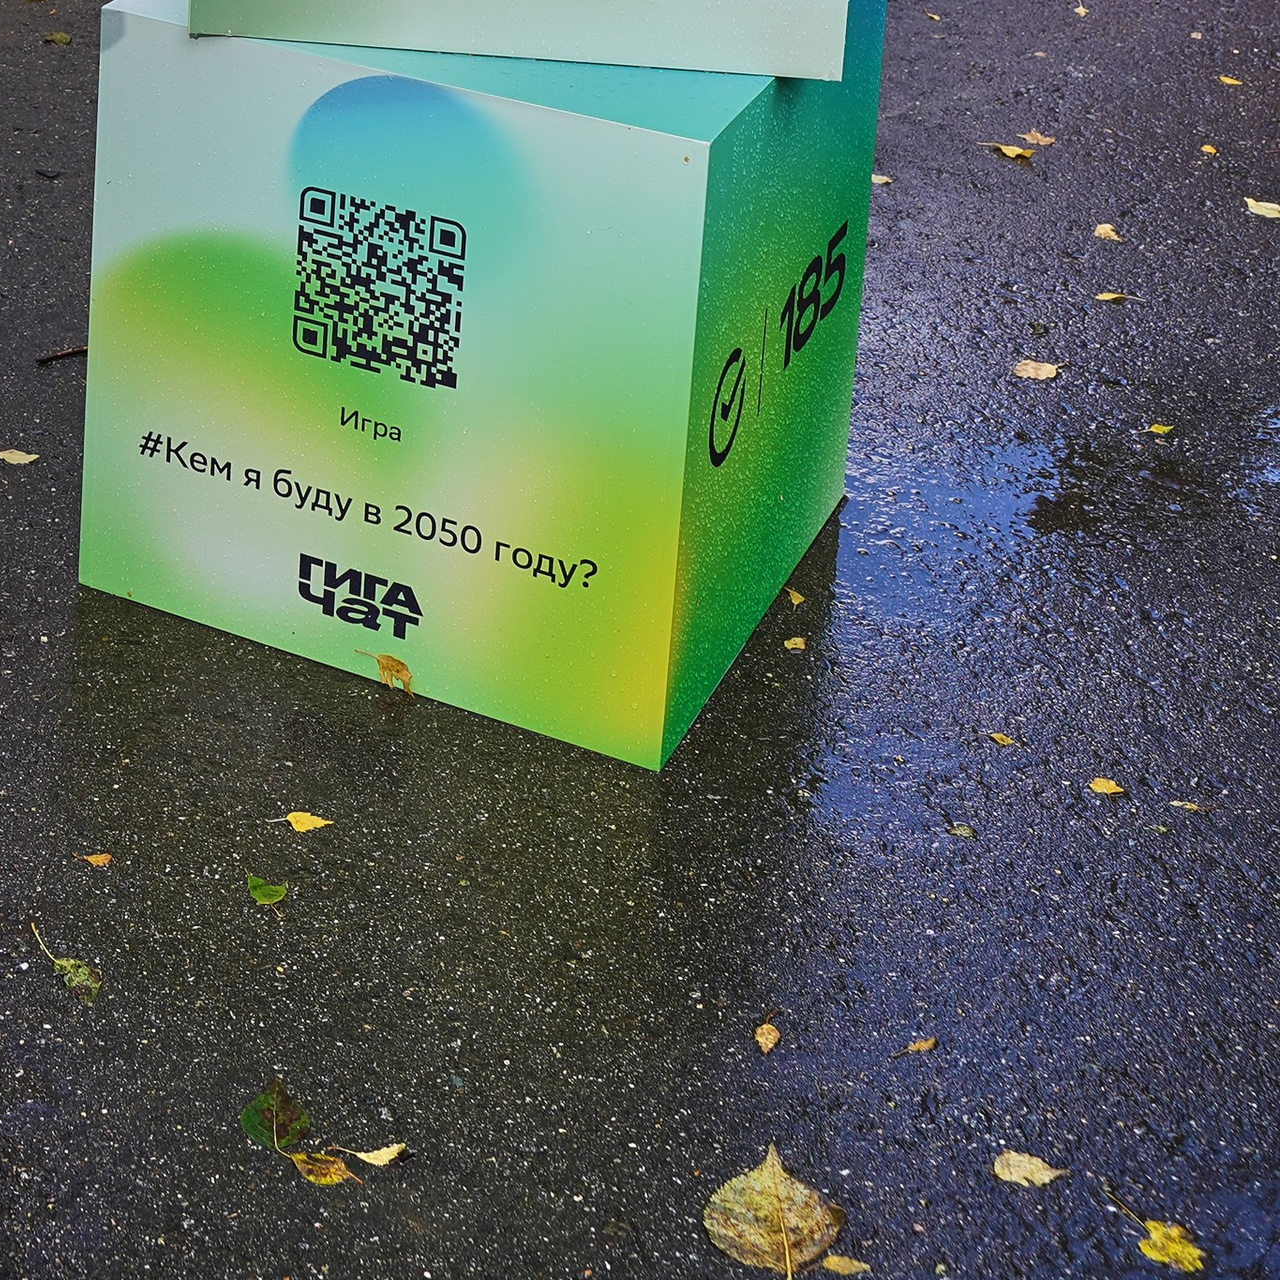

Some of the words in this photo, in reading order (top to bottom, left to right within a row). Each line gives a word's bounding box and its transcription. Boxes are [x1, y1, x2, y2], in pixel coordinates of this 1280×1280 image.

[779, 218, 849, 371] 185
[340, 406, 402, 443] Игра
[138, 430, 232, 482] #Кем
[243, 468, 261, 490] я
[273, 469, 353, 522] буду
[363, 502, 382, 526] в
[393, 505, 482, 554] 2050
[494, 541, 598, 589] году?
[298, 552, 424, 617] ГИГА
